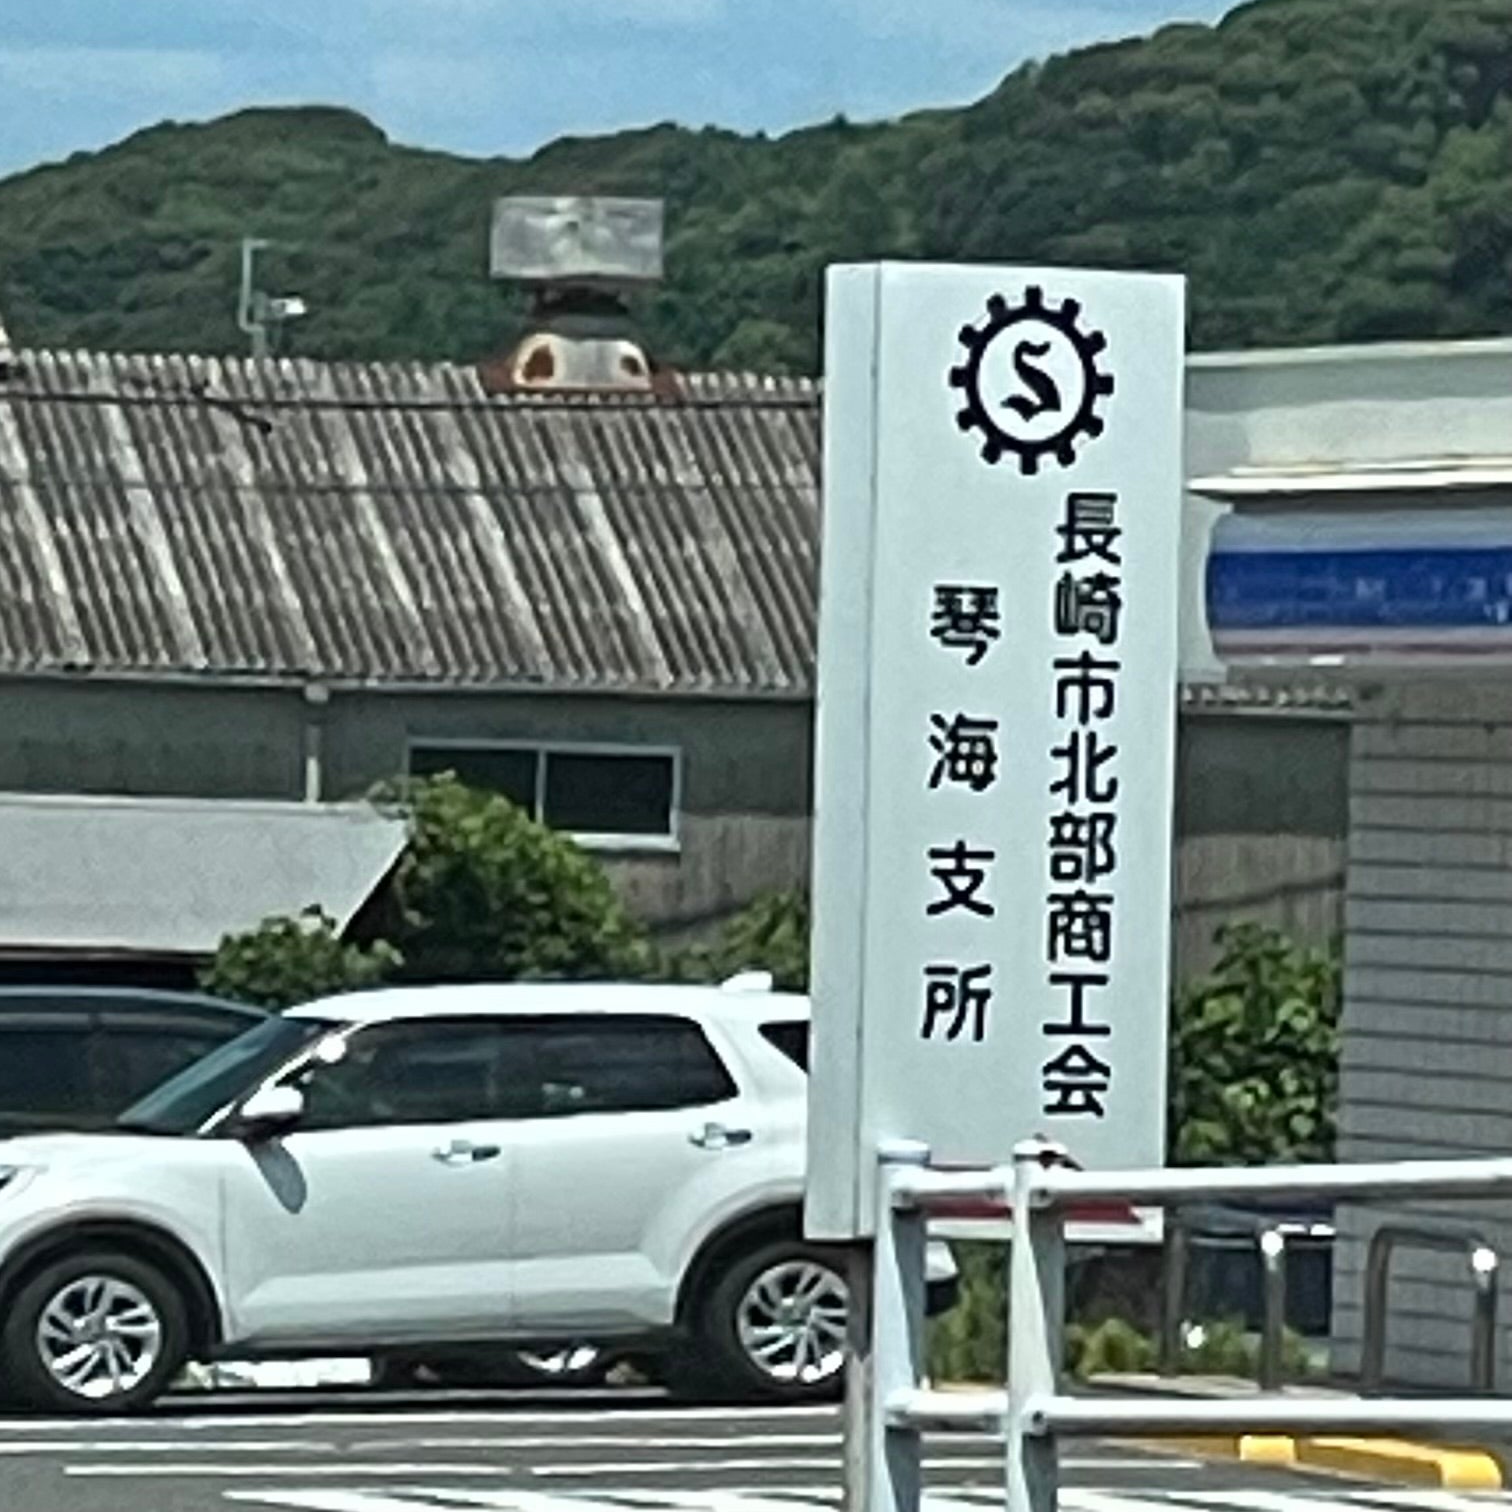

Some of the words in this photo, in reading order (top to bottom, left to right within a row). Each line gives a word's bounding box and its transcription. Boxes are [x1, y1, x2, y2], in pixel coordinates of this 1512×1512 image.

[919, 585, 1001, 1041] 琴海支所
[1042, 492, 1122, 1117] 長崎市北部商工会
